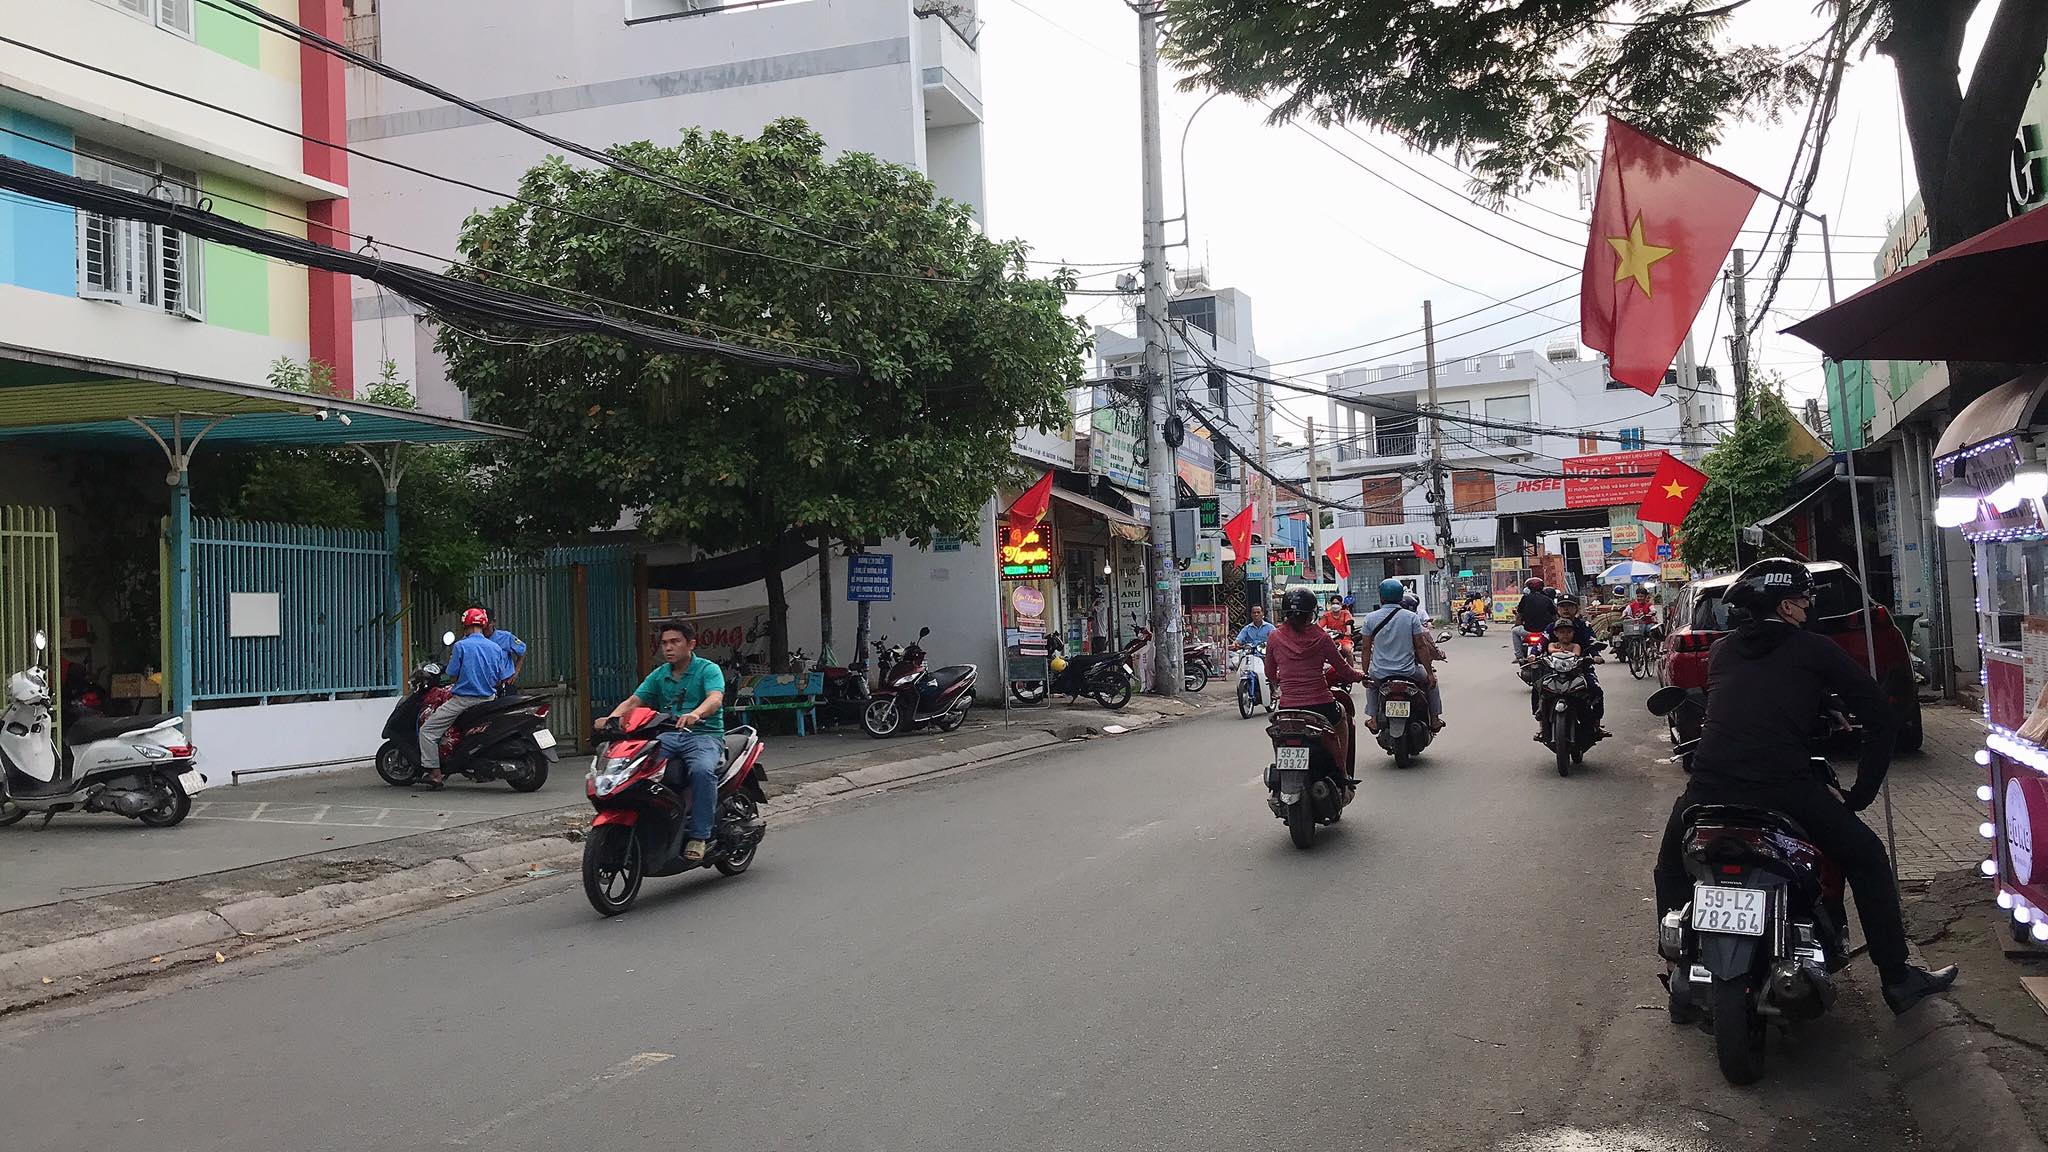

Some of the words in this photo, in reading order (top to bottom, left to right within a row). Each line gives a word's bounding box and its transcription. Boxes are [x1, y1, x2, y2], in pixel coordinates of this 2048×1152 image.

[1565, 466, 1611, 483] Ngọc
[1616, 461, 1639, 475] Tú
[1516, 480, 1561, 493] INSEE
[1369, 532, 1429, 548] THOR
[1124, 578, 1137, 588] TÂY
[1121, 590, 1141, 598] ANH
[1121, 600, 1141, 609] THƯ
[1281, 748, 1305, 759] 59-X2
[1277, 758, 1308, 769] 793.27
[1704, 889, 1755, 911] 59-L2
[1696, 908, 1759, 932] 782.64
